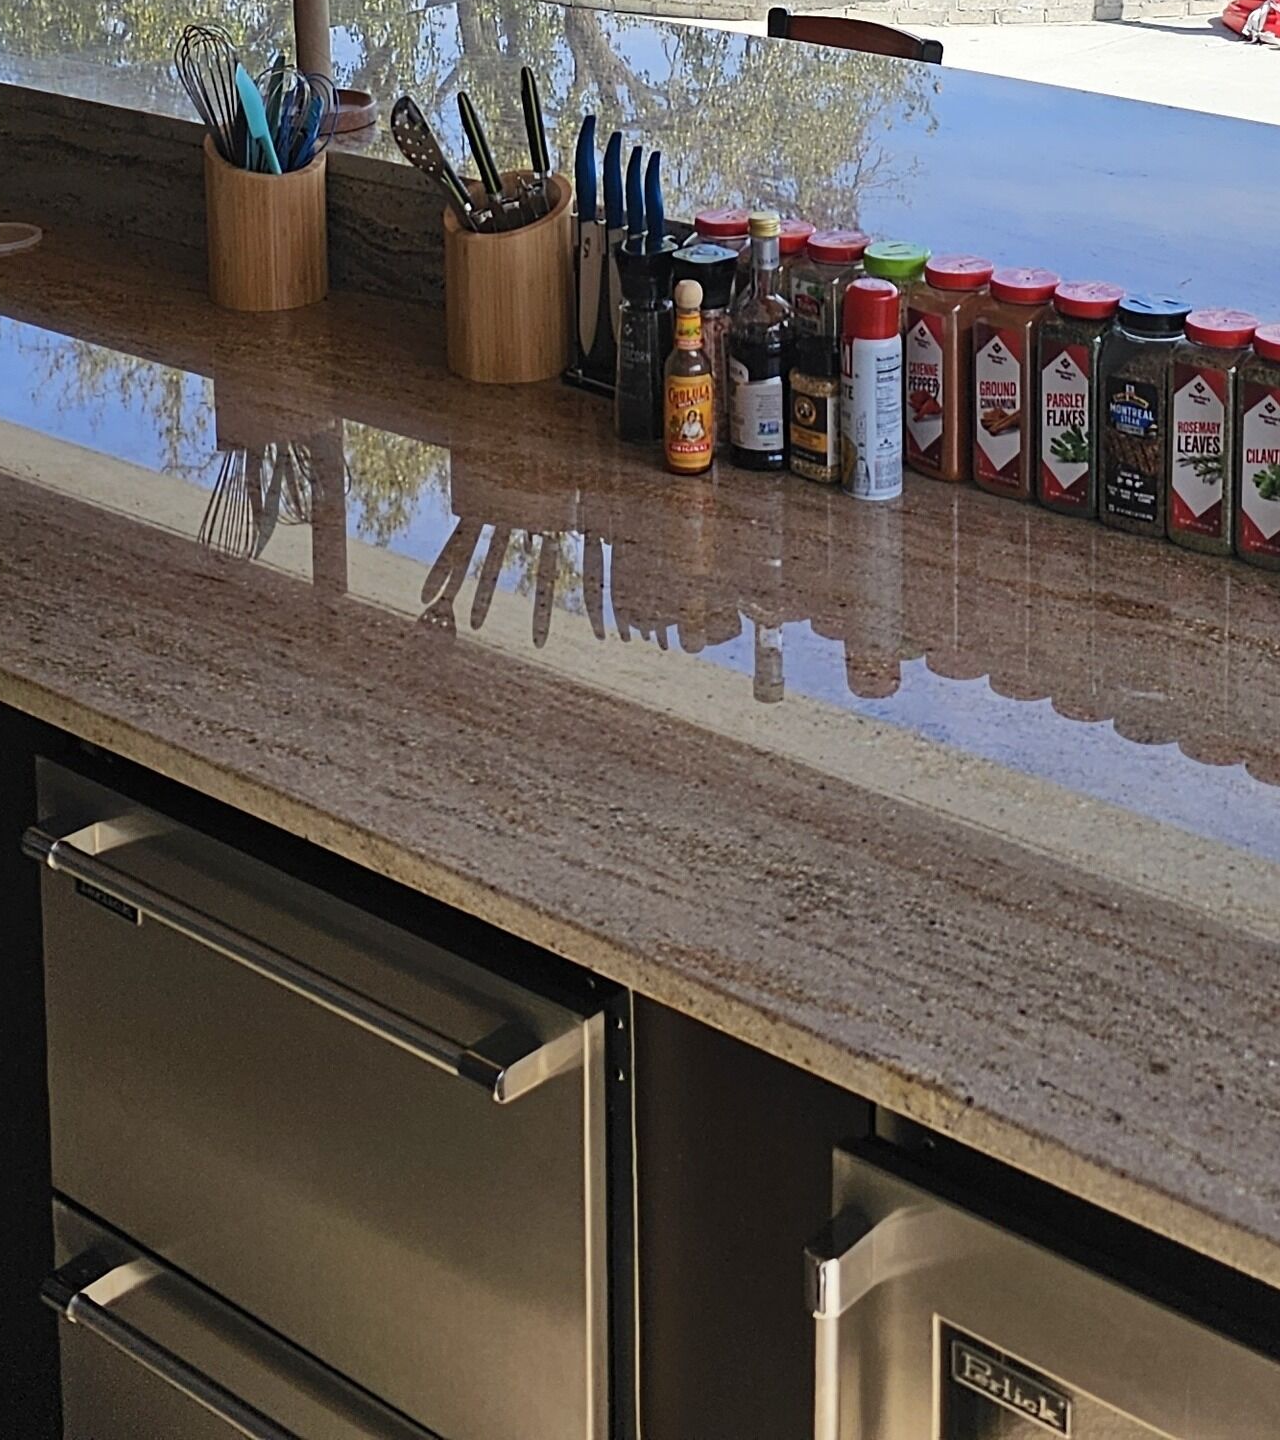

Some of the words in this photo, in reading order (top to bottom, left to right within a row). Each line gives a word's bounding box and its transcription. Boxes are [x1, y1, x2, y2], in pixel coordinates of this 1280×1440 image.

[909, 361, 939, 376] CAYENNE
[908, 375, 939, 393] PEPPER
[979, 381, 1017, 397] GROUND
[668, 385, 709, 403] CHOLULA
[1046, 393, 1085, 409] PARSLEY
[980, 397, 1017, 410] CINNAMON
[1110, 402, 1154, 421] MONTREAL
[1046, 409, 1085, 427] FLAKES
[1177, 421, 1221, 434] ROSEMARY
[1177, 435, 1221, 453] LEAVES
